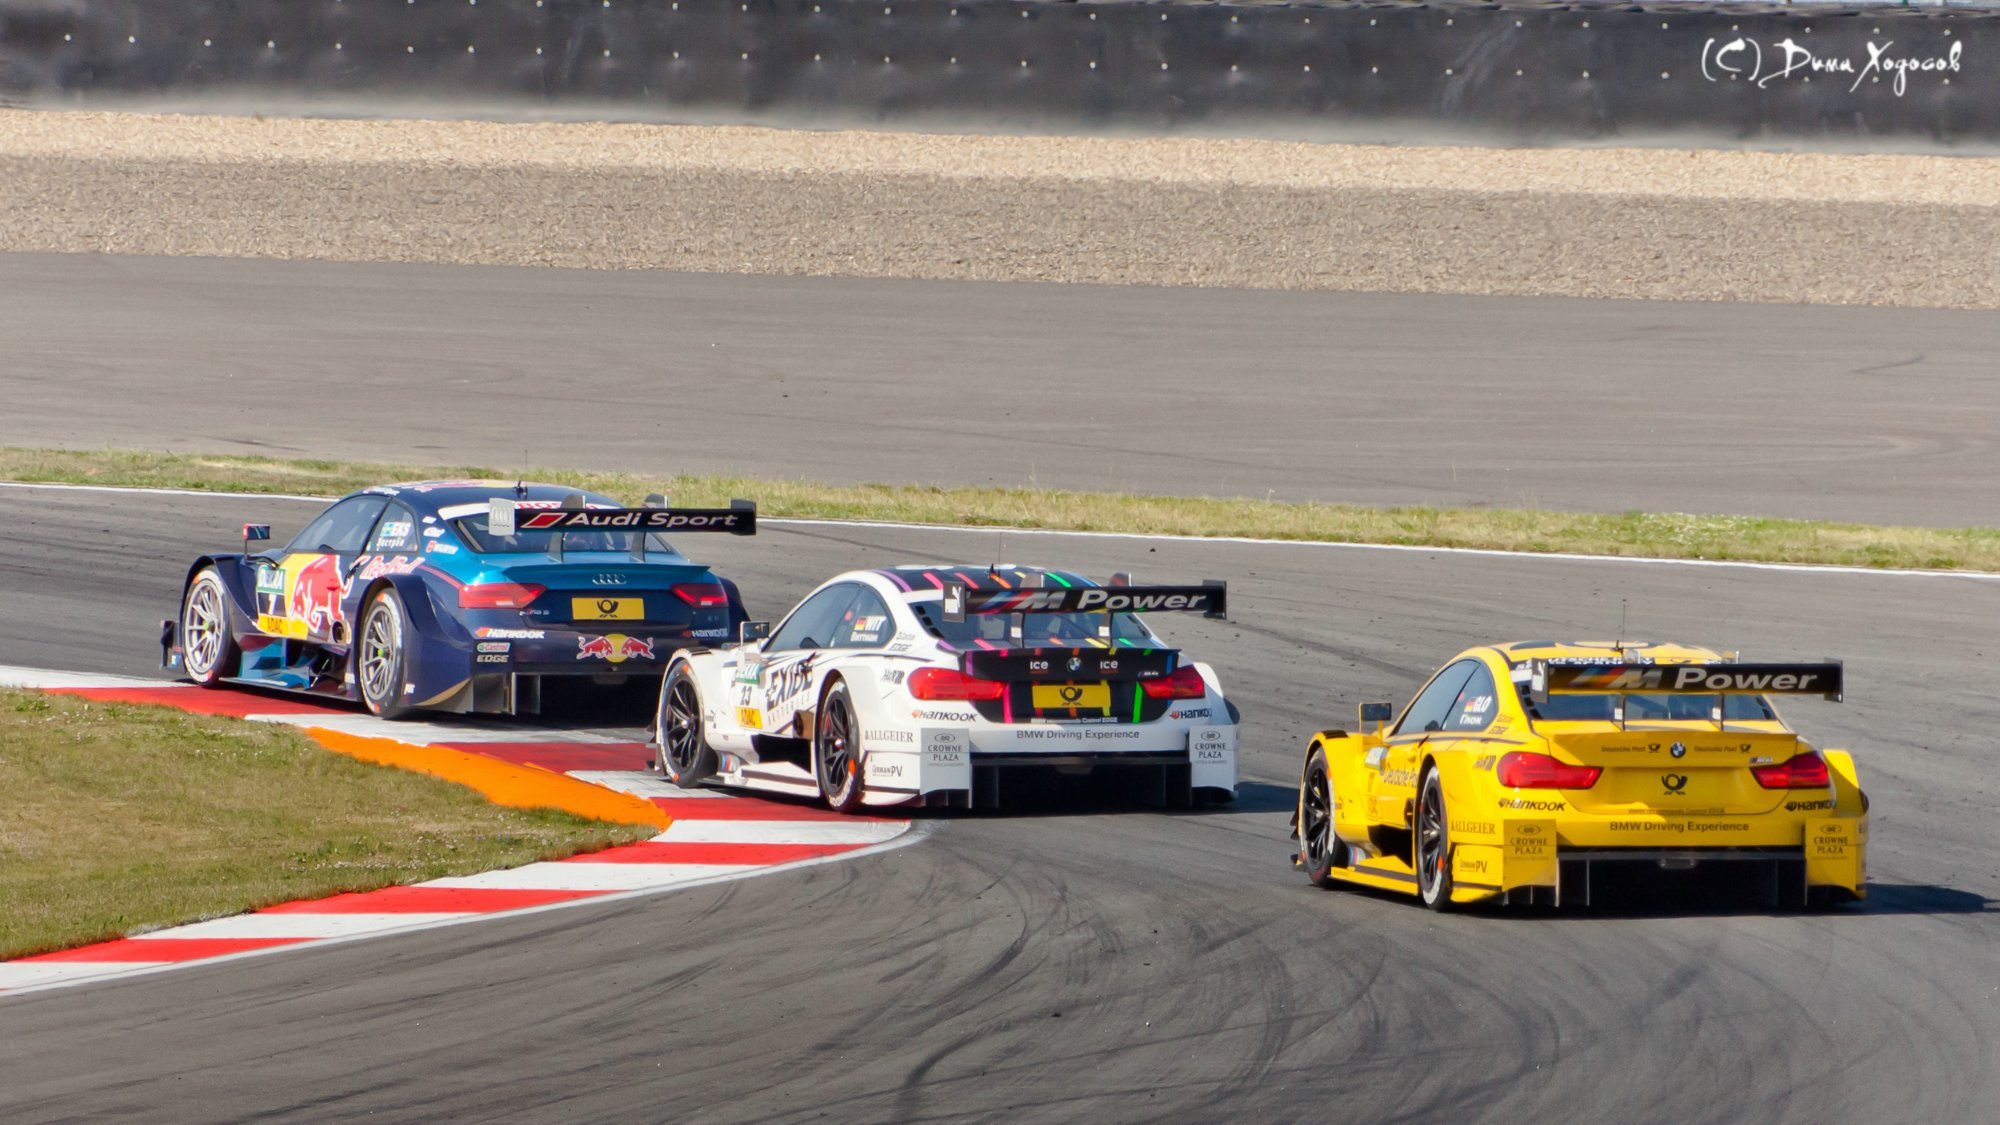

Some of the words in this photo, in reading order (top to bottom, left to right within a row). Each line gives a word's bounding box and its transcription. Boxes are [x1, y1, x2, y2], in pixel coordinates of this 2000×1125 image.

[565, 512, 641, 527] Audi
[648, 512, 738, 528] Sport
[1078, 590, 1208, 610] Power
[865, 616, 887, 631] WIT
[477, 655, 509, 663] EDGE
[1674, 667, 1818, 690] Power
[868, 730, 914, 743] ALLGEIER
[1016, 730, 1044, 739] BMW
[1047, 729, 1082, 741] Driving
[1085, 729, 1140, 740] Experience
[928, 744, 962, 752] CROWNE
[934, 753, 959, 761] PLAZA
[1199, 751, 1222, 759] PLAZA
[1454, 820, 1496, 834] ALLGEIER
[1610, 821, 1642, 831] BMW
[1644, 821, 1684, 833] Driving
[1687, 821, 1749, 832] Experience
[1511, 837, 1547, 846] CROWNE
[1813, 836, 1849, 845] CROWNE
[1515, 846, 1543, 855] PLAZA
[1817, 846, 1843, 854] PLAZA
